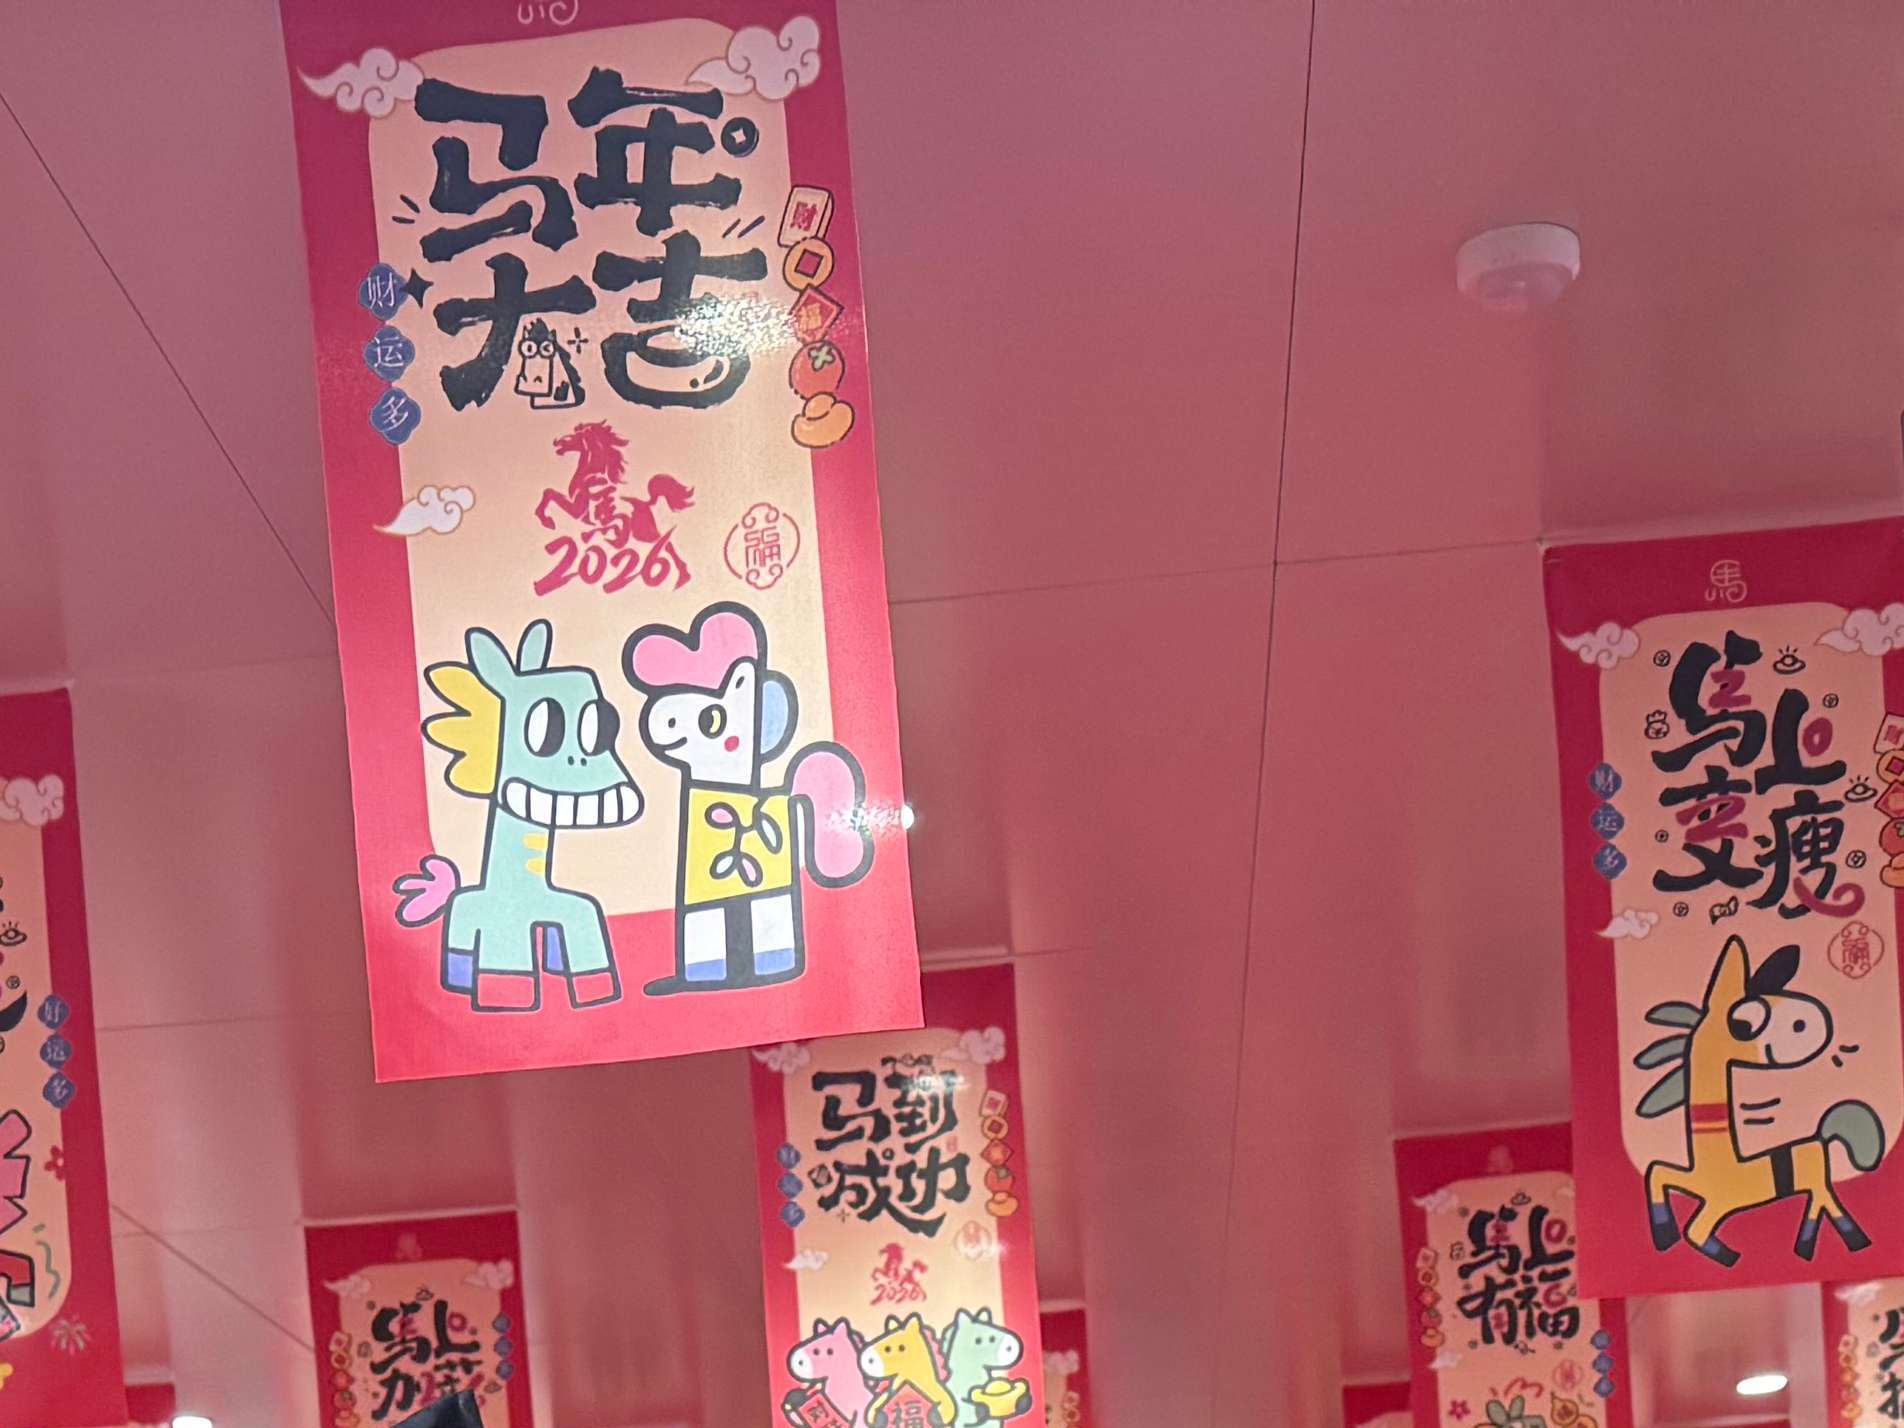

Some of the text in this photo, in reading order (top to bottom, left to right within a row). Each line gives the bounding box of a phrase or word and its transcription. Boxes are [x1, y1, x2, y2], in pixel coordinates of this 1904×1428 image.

[367, 272, 409, 430] 财运多
[534, 524, 677, 597] 2026
[818, 1145, 971, 1238] 成功
